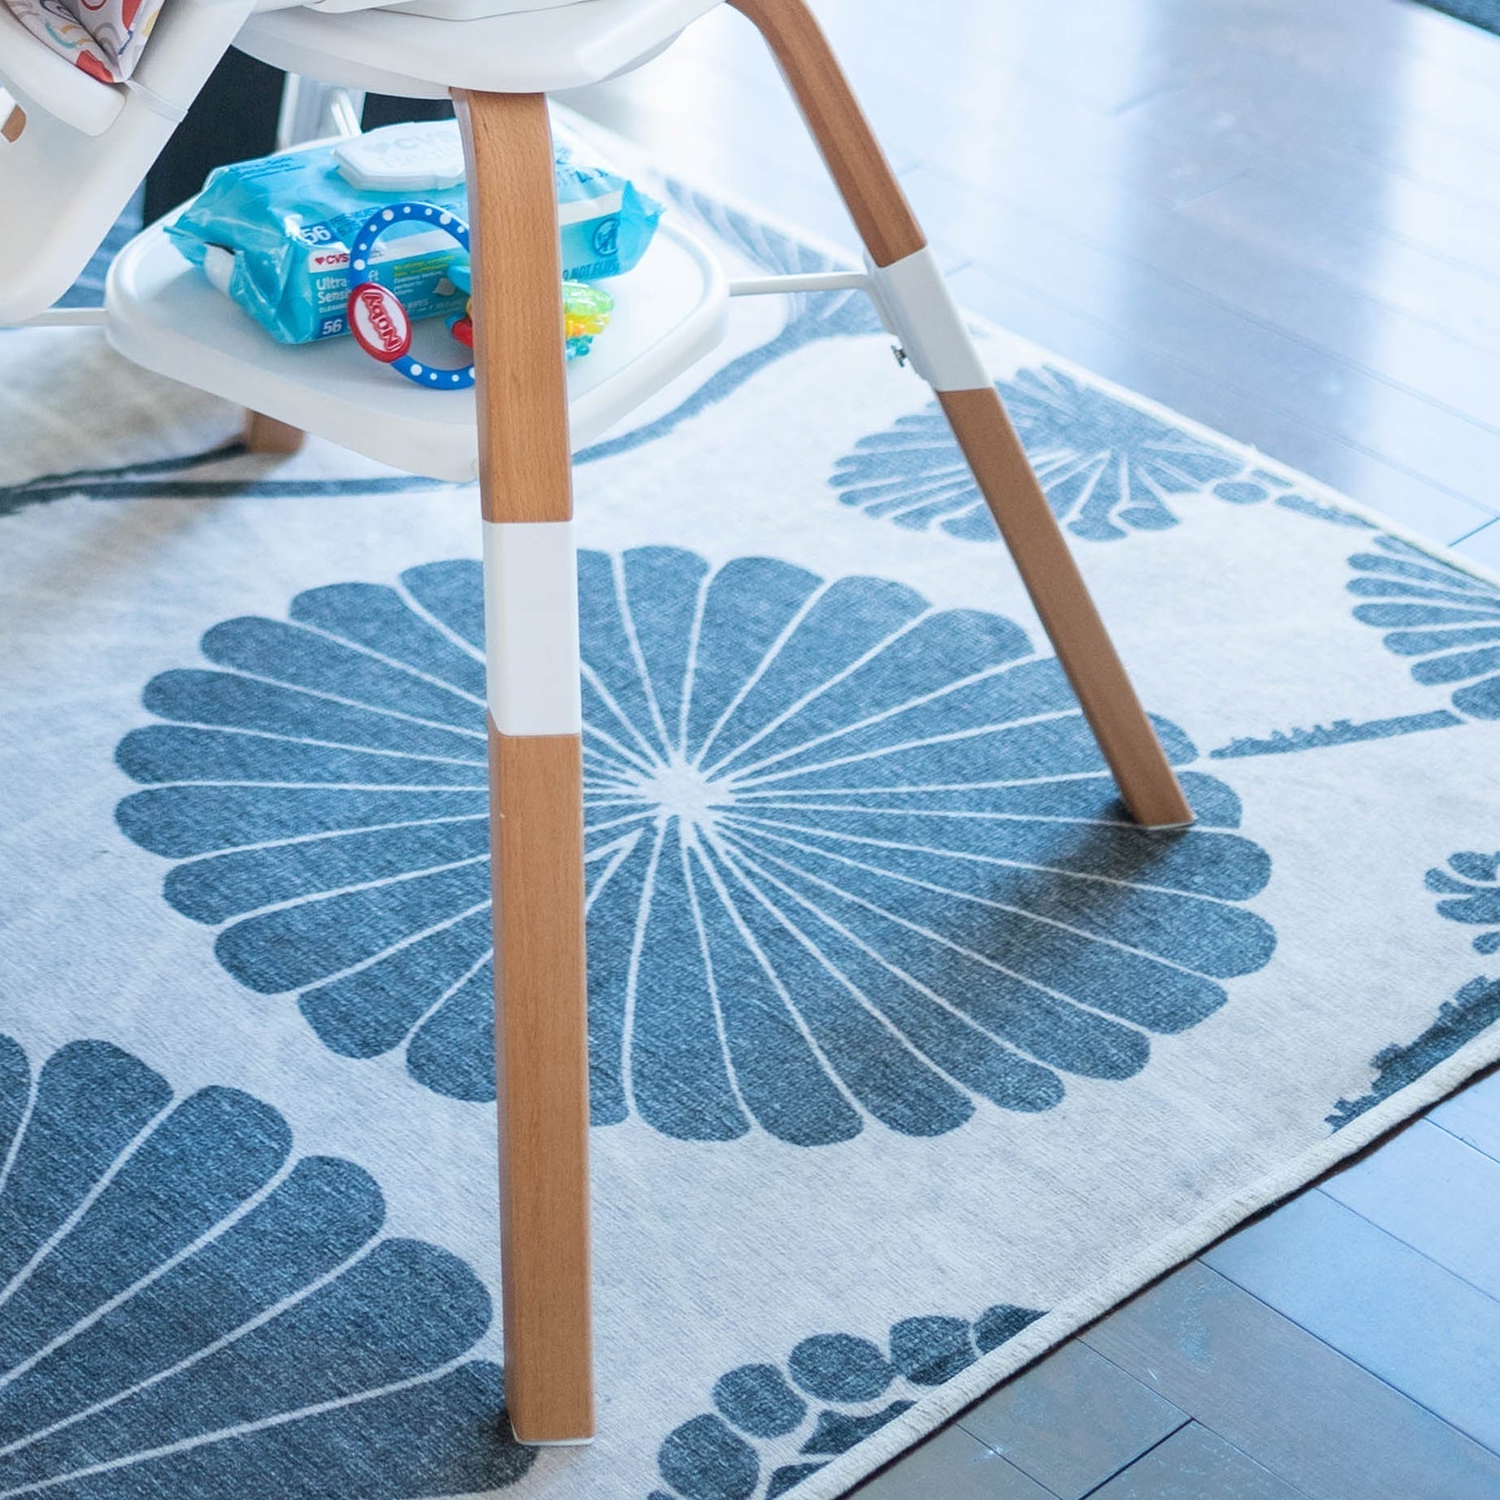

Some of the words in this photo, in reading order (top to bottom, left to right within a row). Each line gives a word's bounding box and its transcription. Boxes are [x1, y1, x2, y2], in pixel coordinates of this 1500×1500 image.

[301, 225, 332, 244] 56
[326, 253, 350, 264] CVS
[571, 263, 591, 280] NOT
[593, 258, 619, 277] FLUS
[316, 277, 347, 290] Ultra
[322, 319, 343, 335] 56
